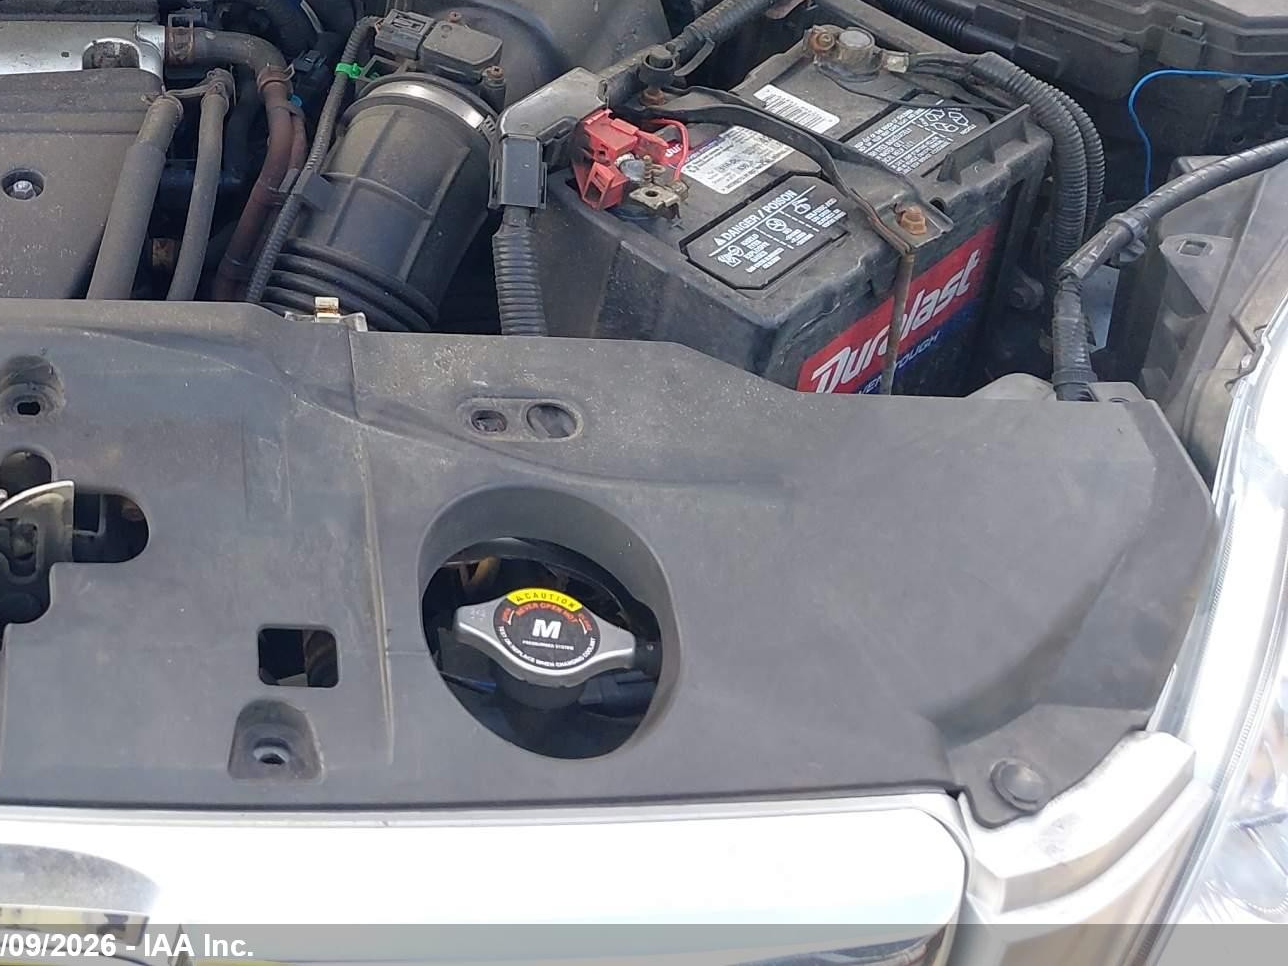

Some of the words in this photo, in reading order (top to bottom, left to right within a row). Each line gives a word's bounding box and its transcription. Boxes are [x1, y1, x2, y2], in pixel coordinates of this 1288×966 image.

[720, 214, 761, 241] DANGER
[761, 189, 798, 213] POISON
[524, 592, 576, 609] CAUTION
[532, 618, 561, 639] M
